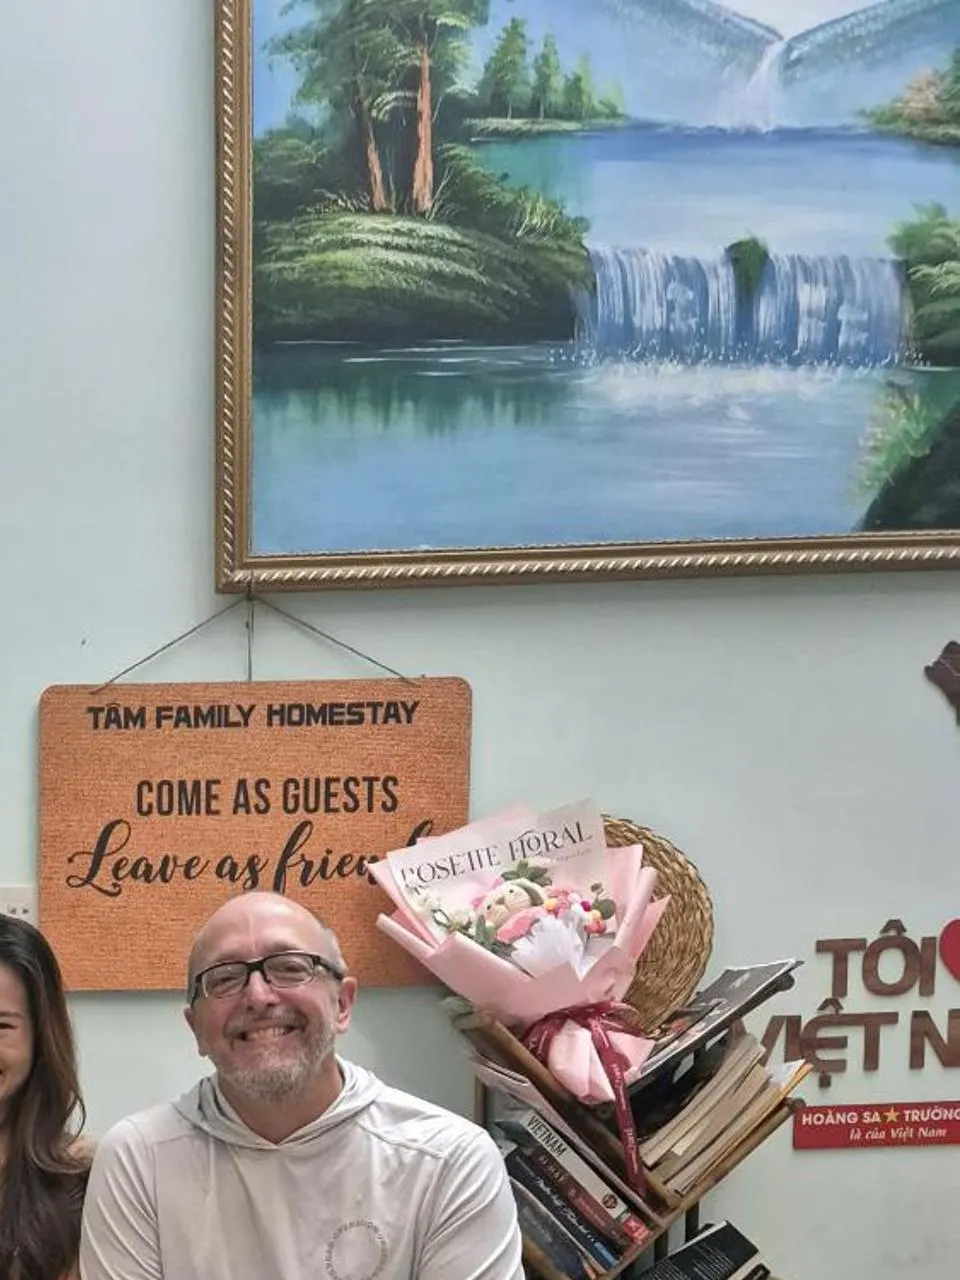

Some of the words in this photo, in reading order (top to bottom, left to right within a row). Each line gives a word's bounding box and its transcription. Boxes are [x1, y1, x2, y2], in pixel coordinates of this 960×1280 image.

[88, 702, 146, 730] TÂM
[155, 704, 256, 729] FAMILY
[266, 700, 419, 727] HOMESTAY
[136, 779, 221, 816] COME
[233, 778, 271, 815] AS
[282, 775, 400, 814] GUESTS
[66, 818, 210, 897] Leave
[215, 854, 269, 890] as
[273, 820, 434, 896] frien
[815, 919, 938, 998] TÔI
[527, 1115, 568, 1158] VIETNAM
[802, 1108, 858, 1125] HOÀNG
[862, 1111, 881, 1123] SA
[918, 1126, 948, 1139] Nam
